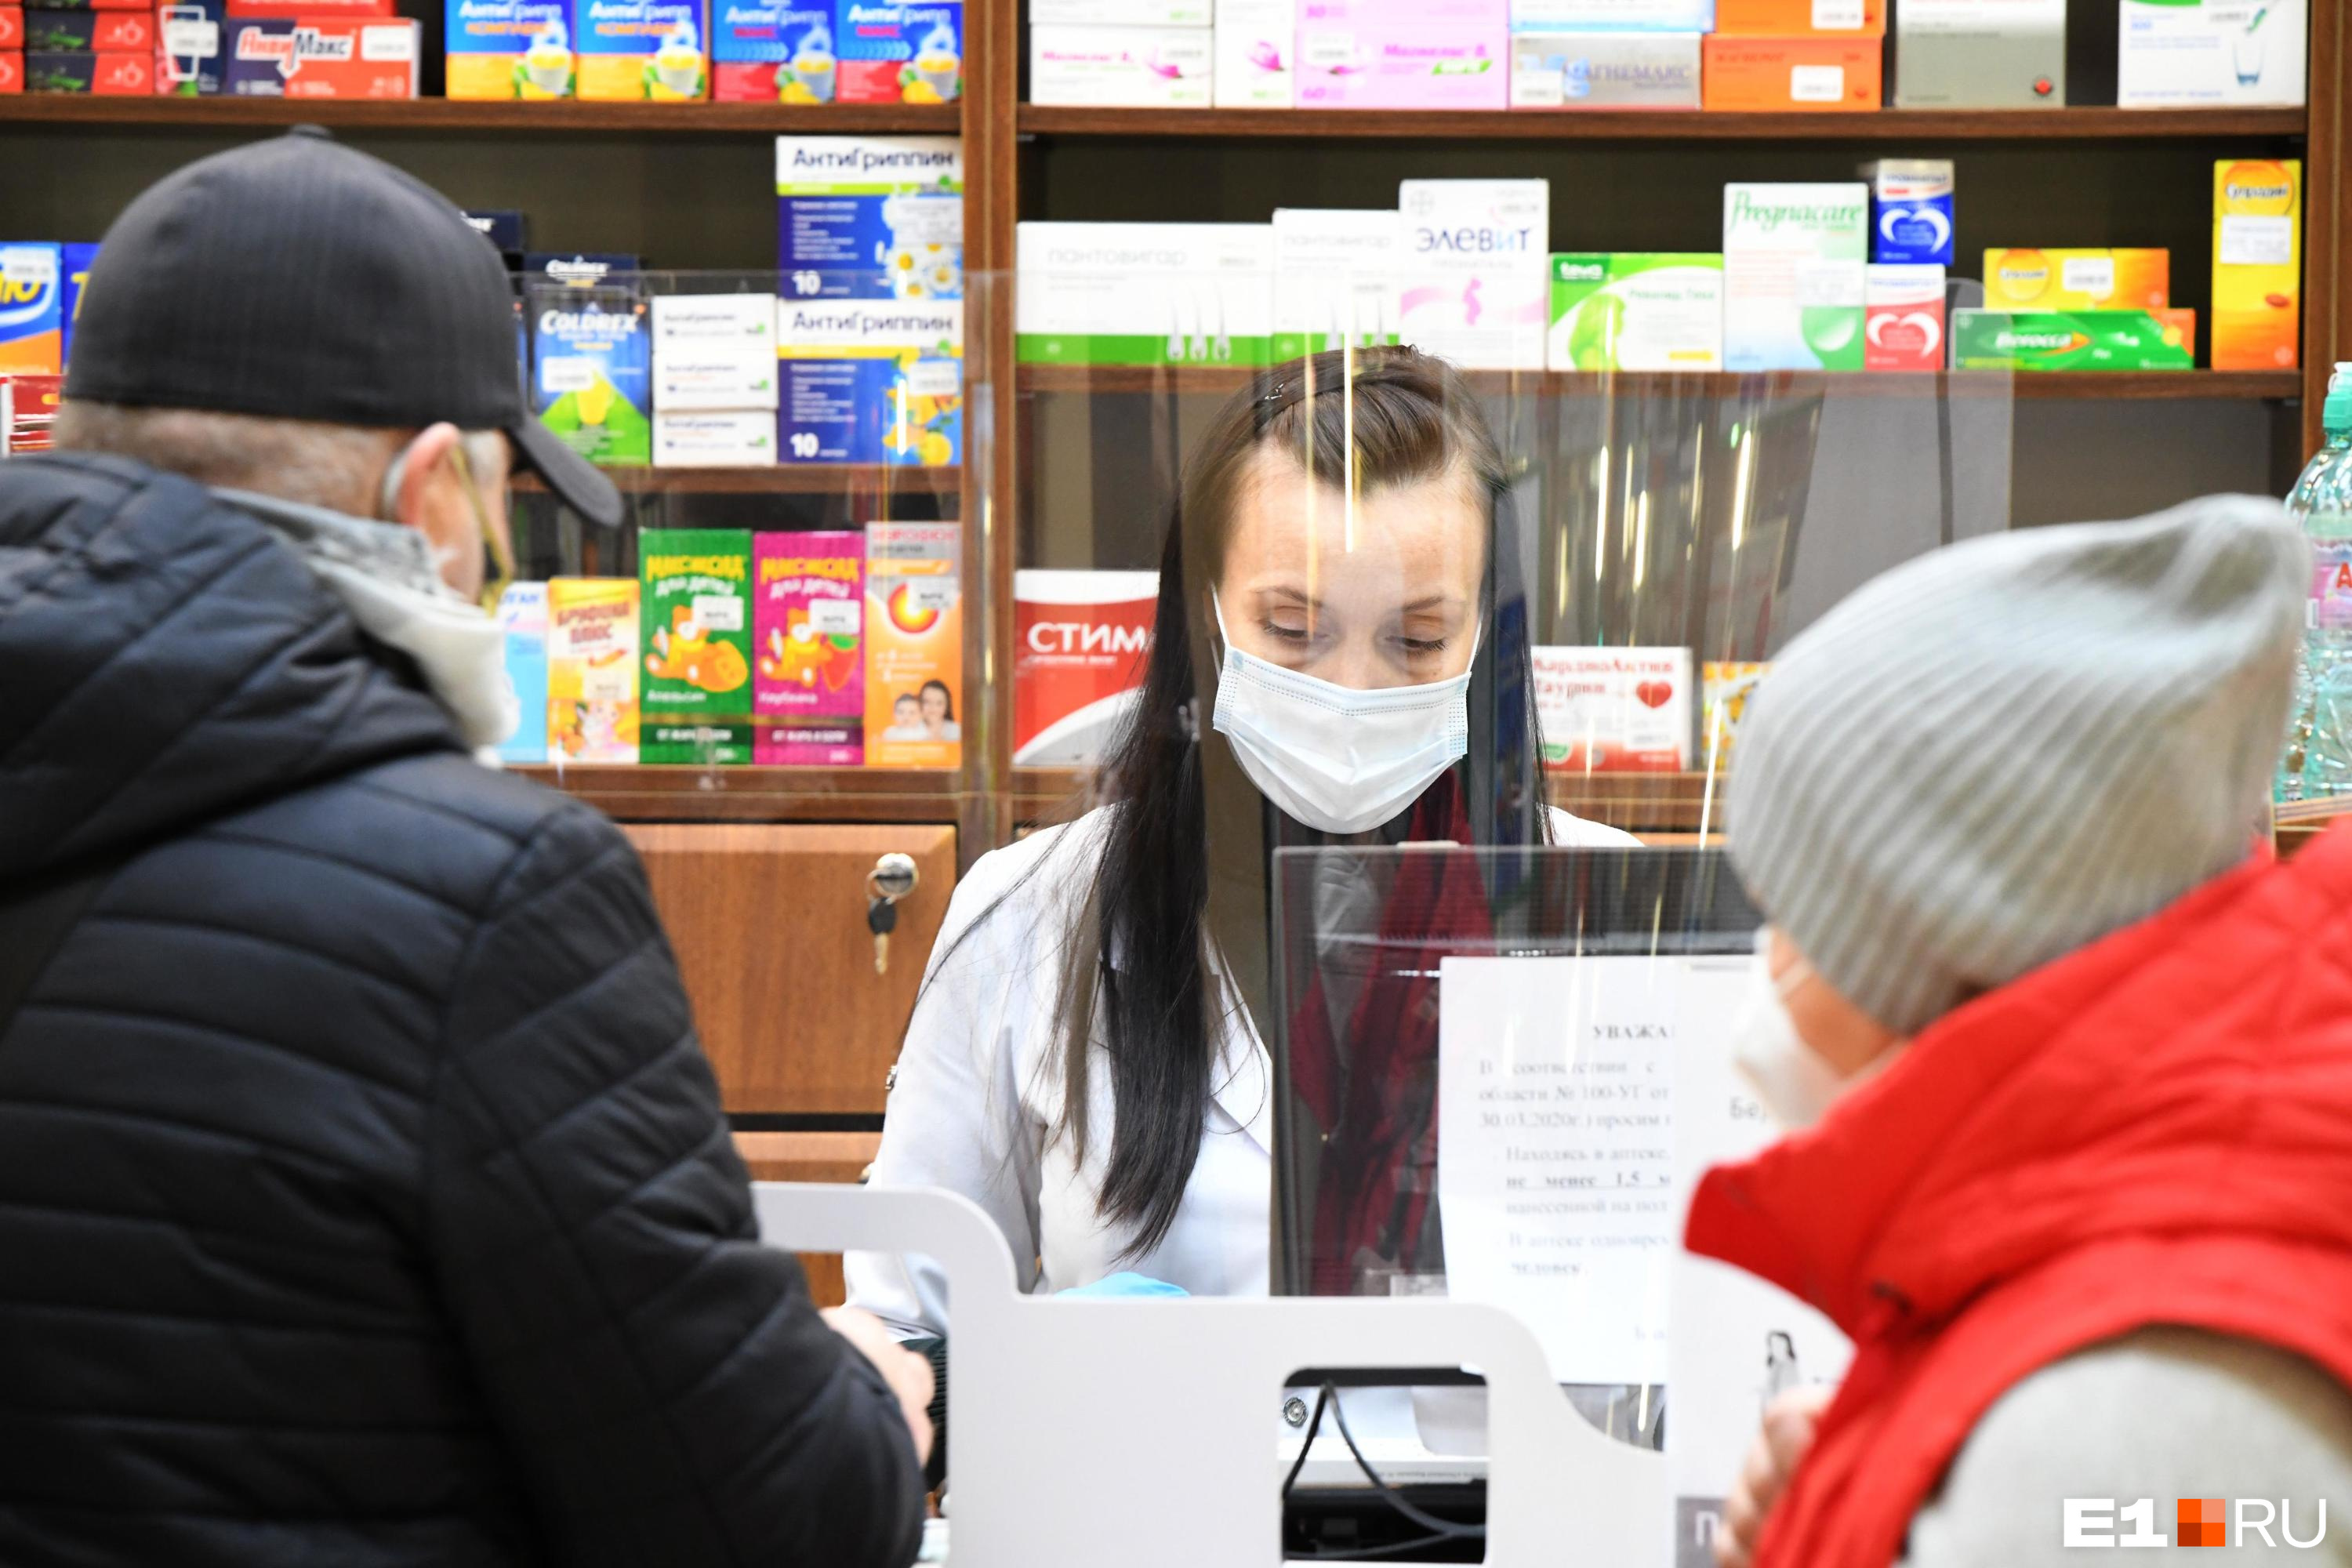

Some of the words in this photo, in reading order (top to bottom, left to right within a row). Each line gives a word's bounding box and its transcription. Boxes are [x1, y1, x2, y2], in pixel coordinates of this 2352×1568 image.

[793, 148, 953, 172] АнтиГриппин
[792, 270, 821, 295] 10
[540, 310, 641, 334] COLDREX
[793, 311, 953, 335] АнтиГриппин
[790, 433, 818, 458] 10
[1027, 622, 1156, 653] СТИМ
[1592, 1025, 1672, 1040] УВАЖА
